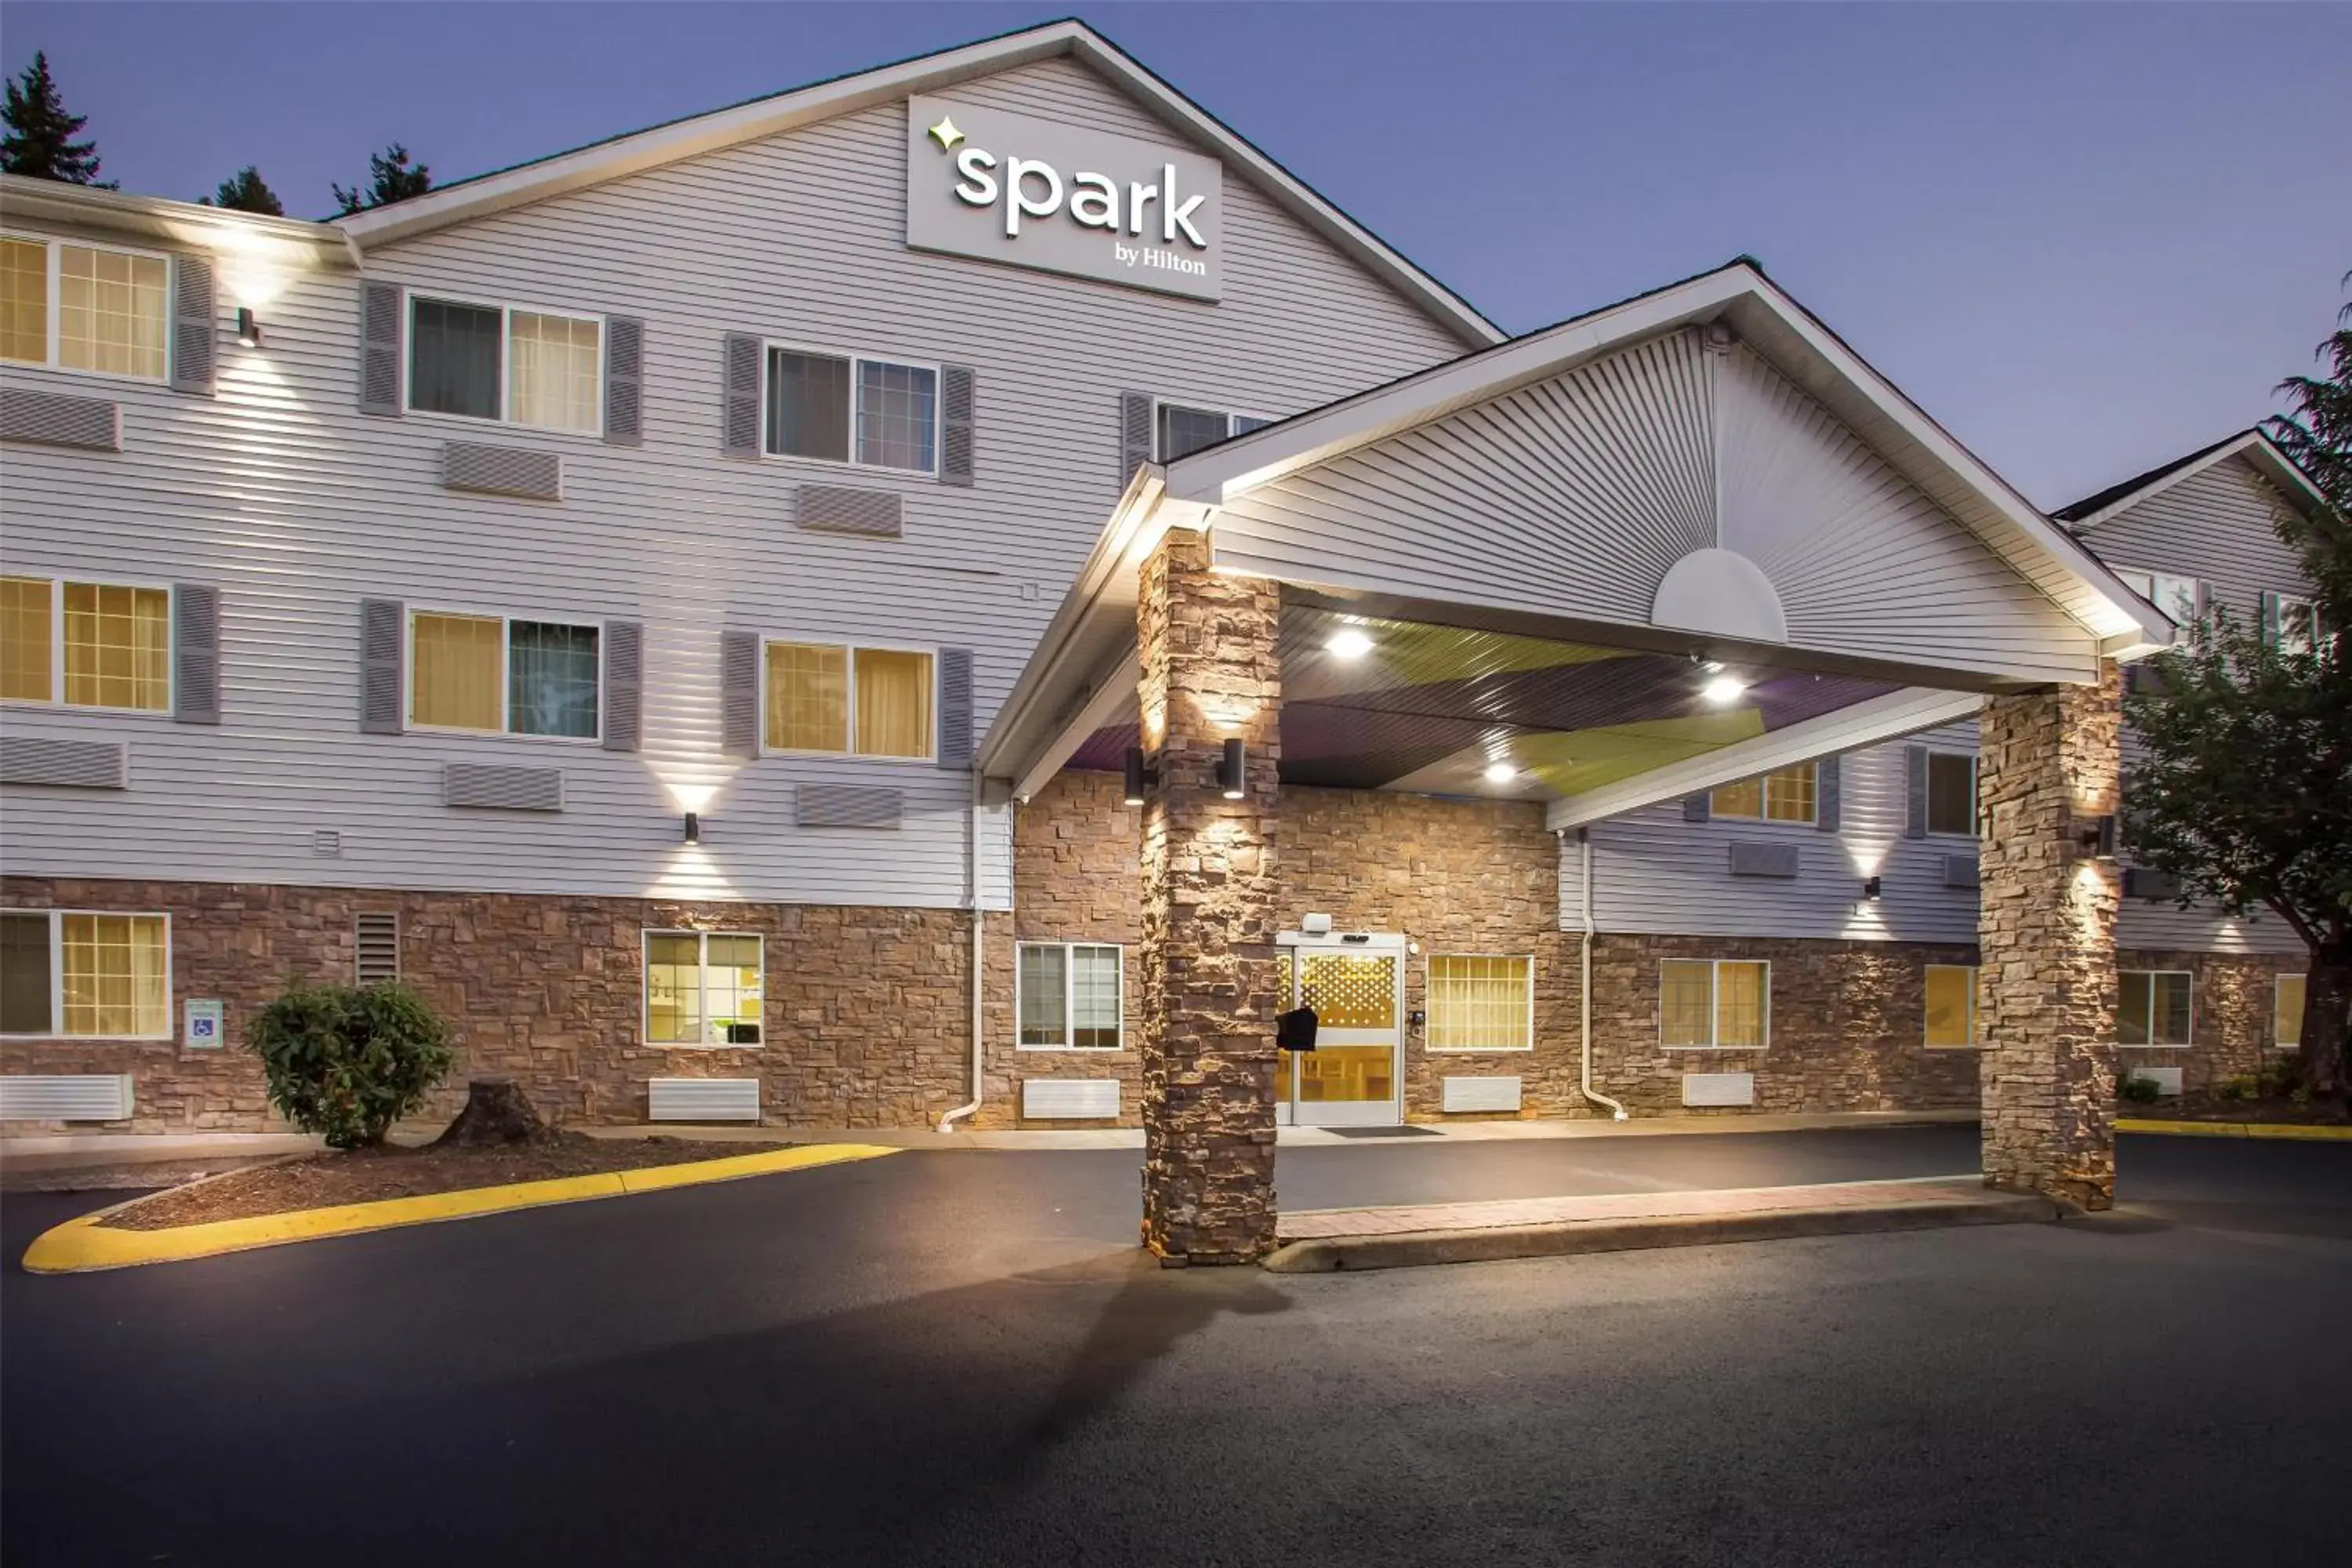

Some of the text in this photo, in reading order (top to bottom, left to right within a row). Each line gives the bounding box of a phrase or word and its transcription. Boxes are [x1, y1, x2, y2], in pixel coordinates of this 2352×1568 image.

[954, 147, 1207, 249] spark
[1115, 241, 1206, 275] by Hilton
